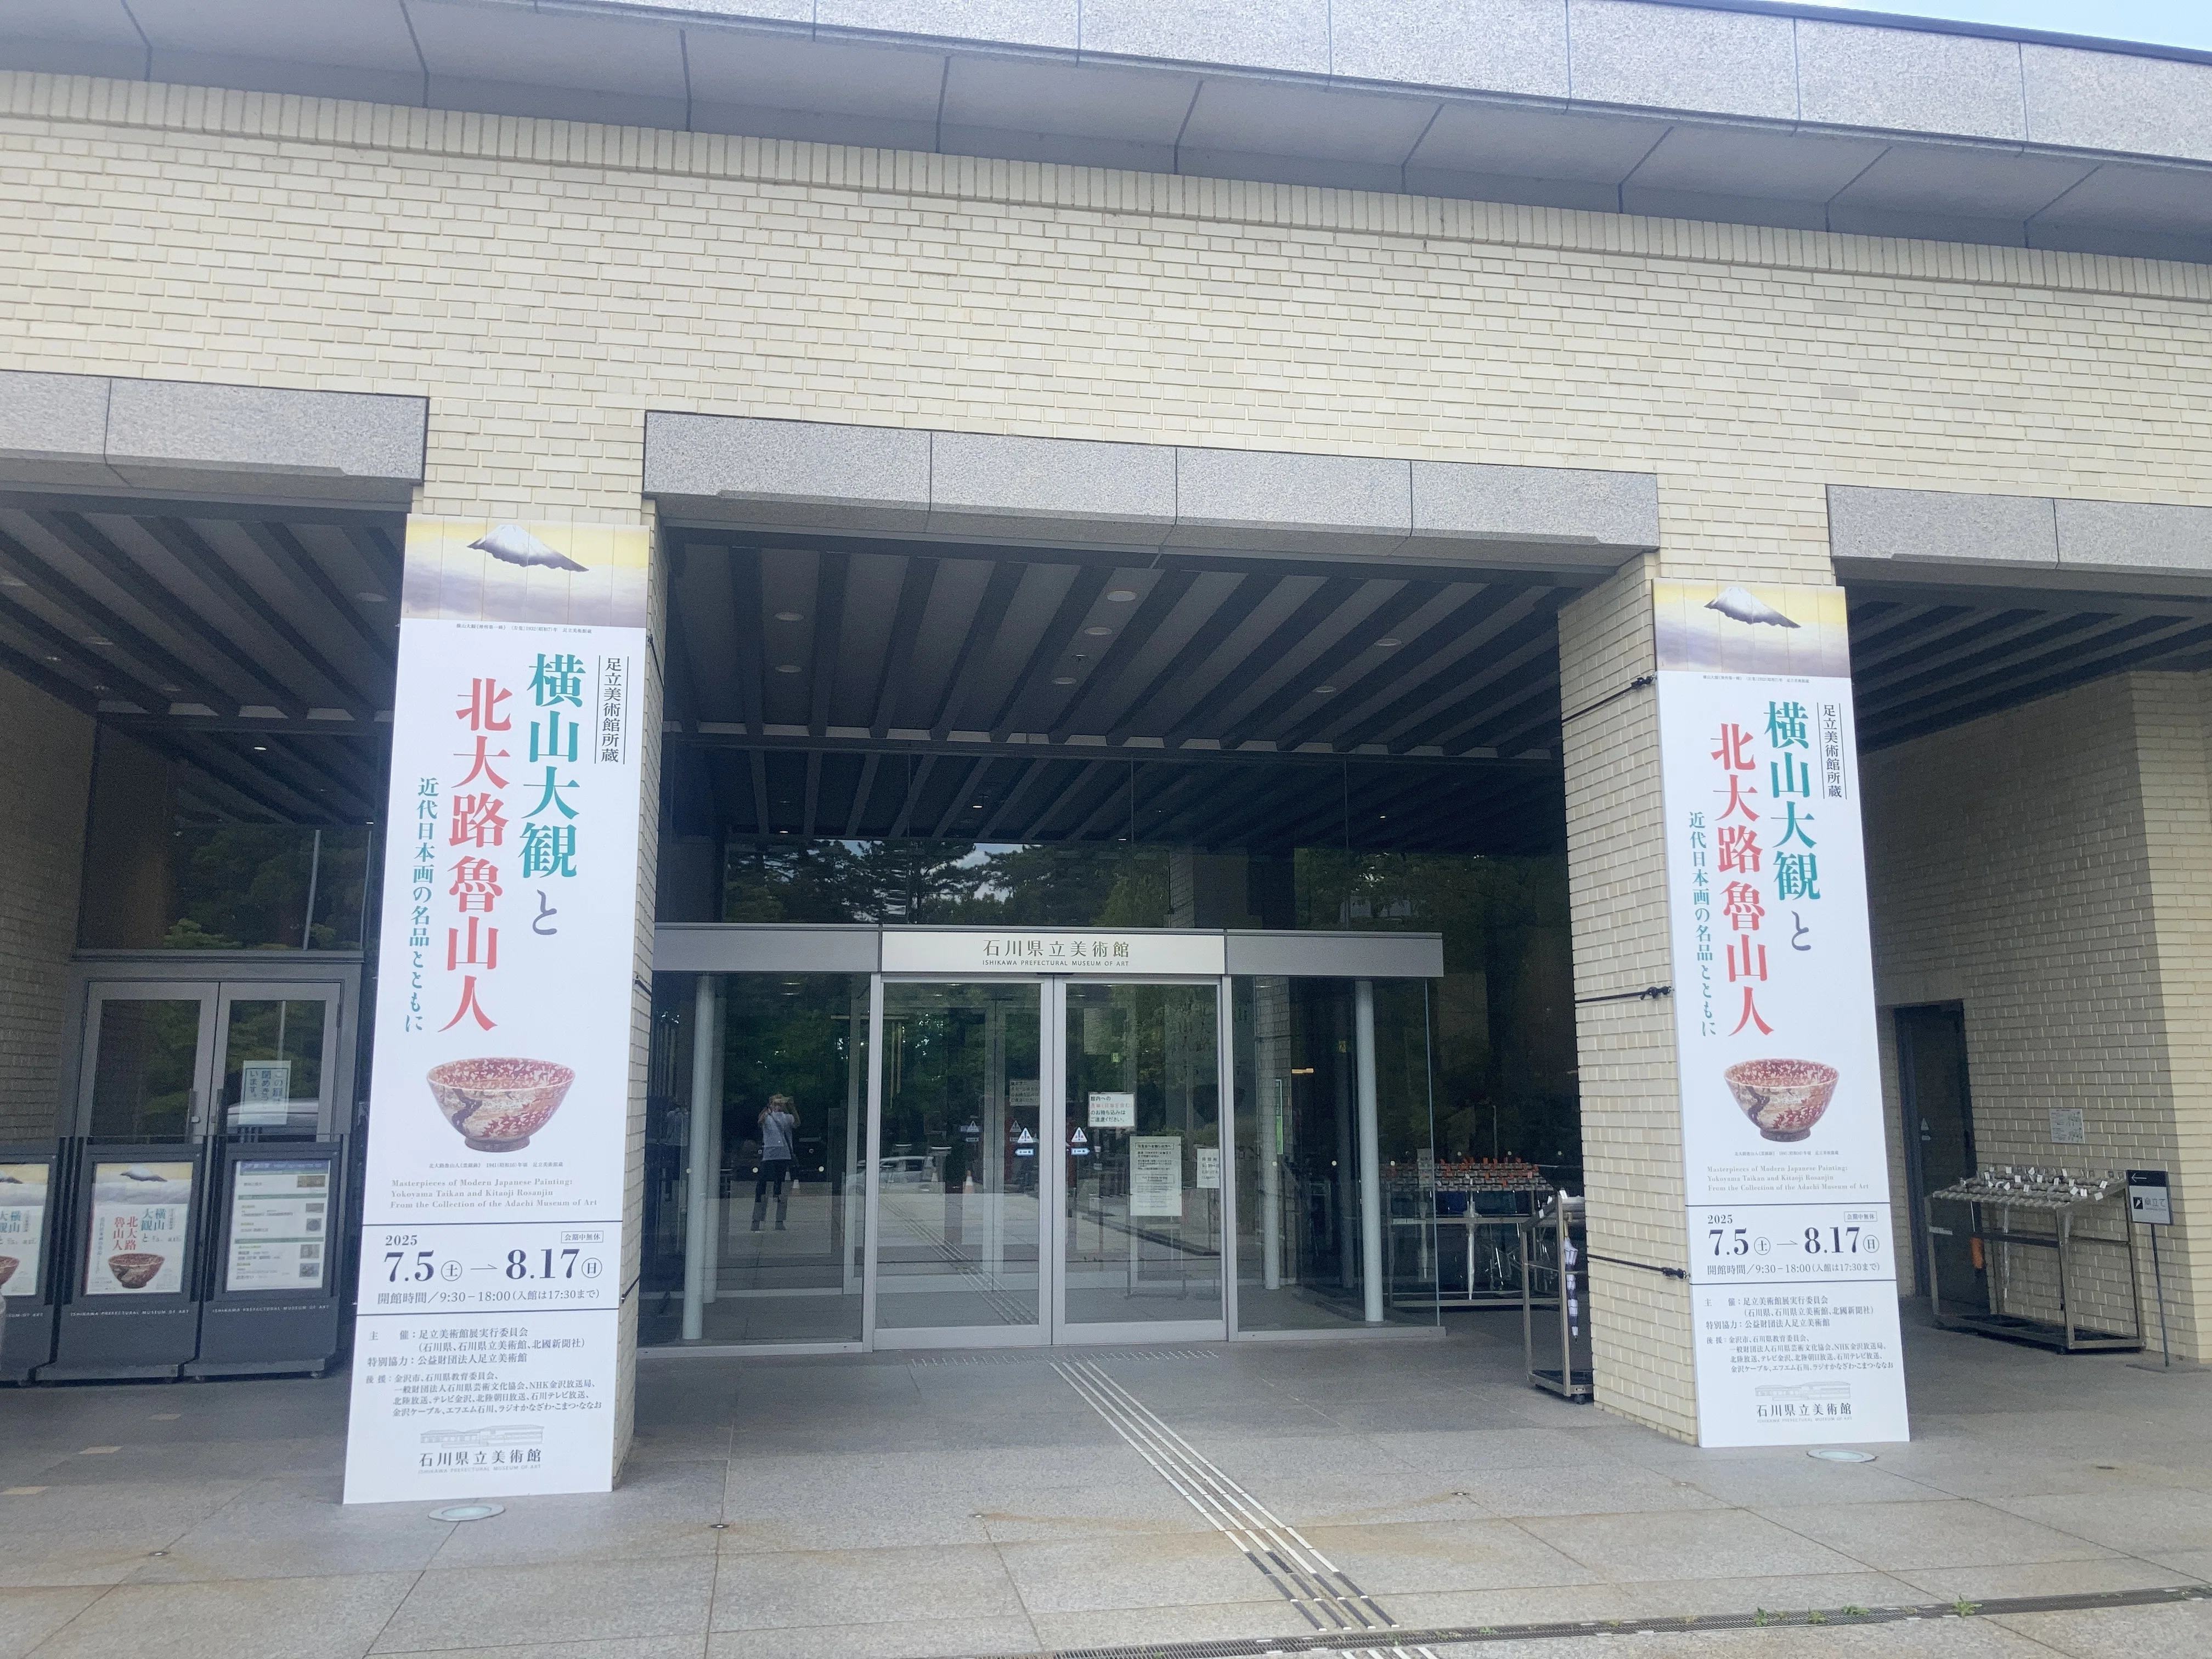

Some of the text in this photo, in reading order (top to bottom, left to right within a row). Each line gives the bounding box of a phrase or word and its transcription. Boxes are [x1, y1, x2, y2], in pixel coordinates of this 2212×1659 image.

[601, 658, 622, 763] 足立美術館所蔵
[1822, 704, 1842, 798] 足立美術館所蔵
[518, 653, 586, 935] 横山大観と
[1763, 701, 1821, 951] 横山大観と
[437, 678, 514, 1032] 北大路魯山人
[1710, 723, 1774, 1037] 北大路魯山人
[405, 777, 439, 1032] 近代日本画の名品とともに
[1688, 811, 1717, 1036] 近代日本画の名品とともに
[983, 940, 1130, 957] 石川県立美術館
[385, 1235, 418, 1246] 2025
[565, 1233, 601, 1242] 会期中無休
[1707, 1214, 1733, 1224] 2025
[1708, 1228, 1748, 1256] 7.5
[1804, 1227, 1860, 1254] 8.17
[384, 1250, 435, 1283] 7.5
[506, 1248, 580, 1280] 8.17
[1757, 1403, 1852, 1417] 石川県立美術館
[419, 1448, 541, 1468] 石川県立美術館
